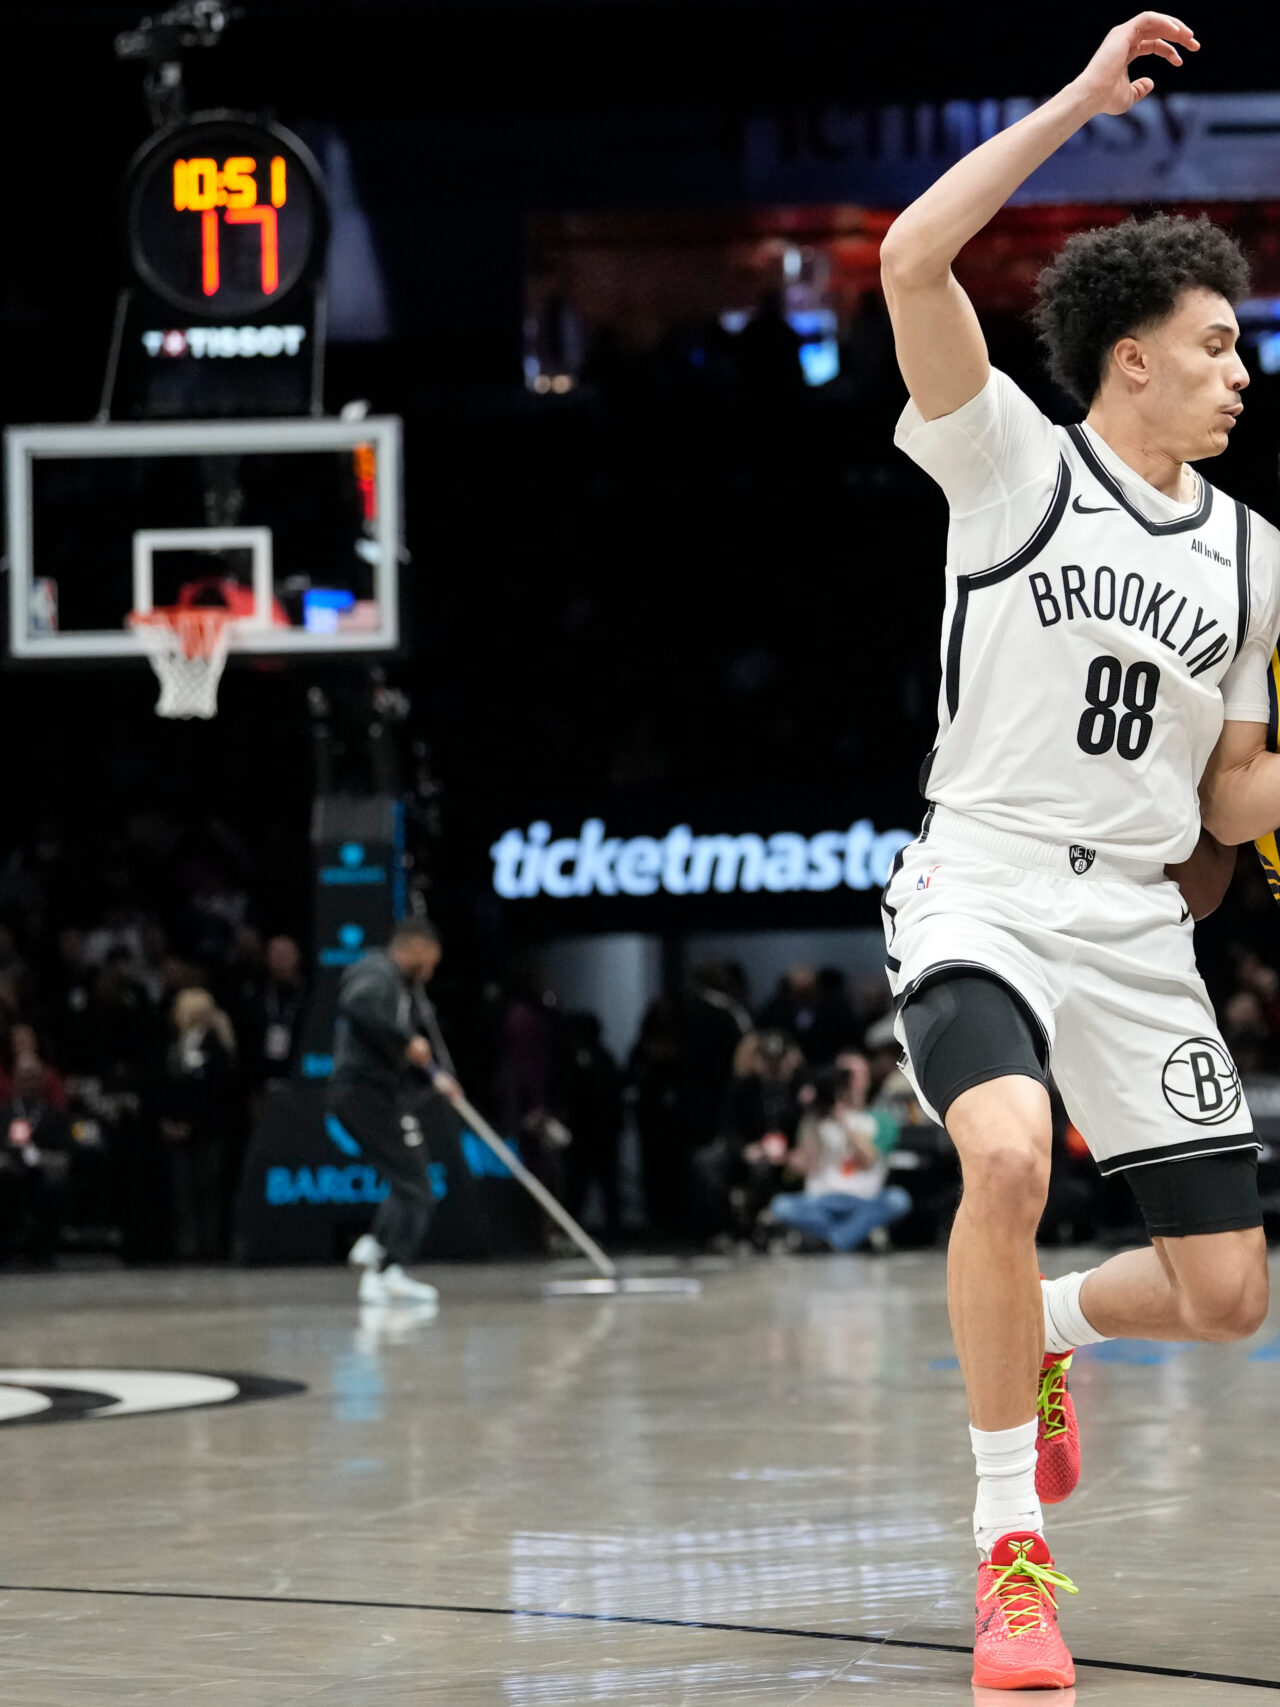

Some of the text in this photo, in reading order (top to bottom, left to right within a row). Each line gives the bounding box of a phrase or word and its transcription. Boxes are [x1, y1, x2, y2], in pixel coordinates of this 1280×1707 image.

[173, 156, 287, 211] 10:51
[202, 205, 279, 296] 17
[1191, 538, 1203, 554] All
[1212, 548, 1232, 568] Won
[1029, 565, 1230, 679] BROOKLYN
[1077, 655, 1160, 760] 88
[1190, 1051, 1224, 1112] B
[266, 1164, 447, 1204] BARCLS
